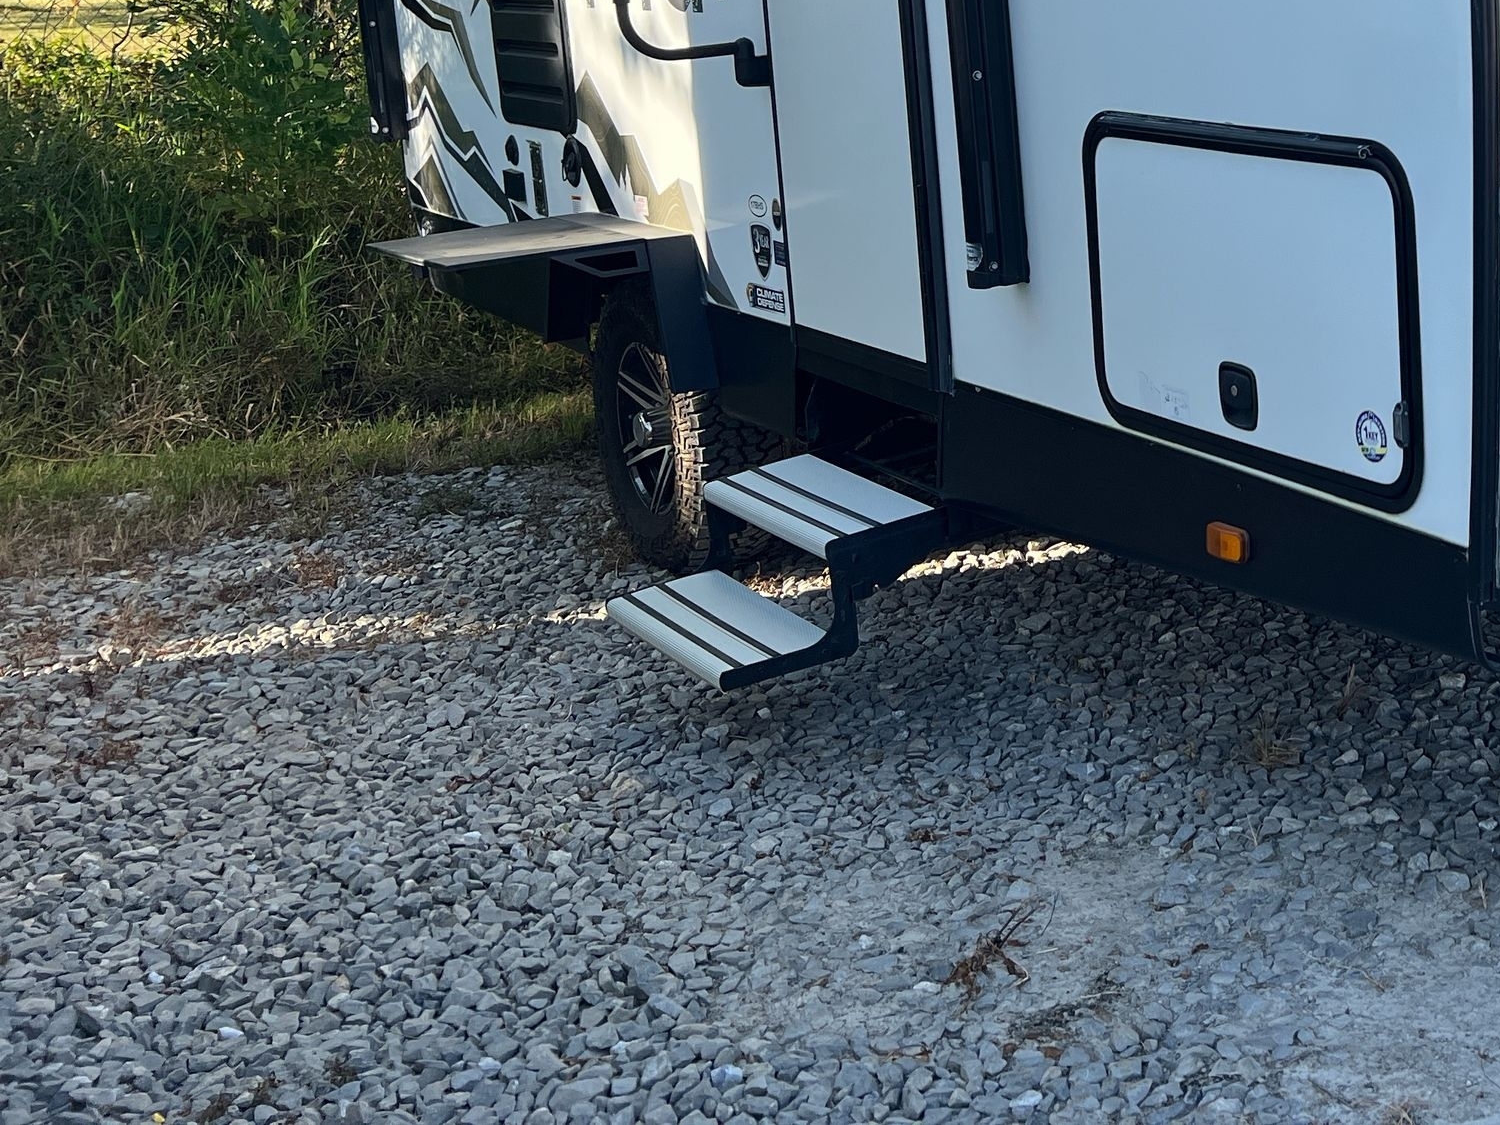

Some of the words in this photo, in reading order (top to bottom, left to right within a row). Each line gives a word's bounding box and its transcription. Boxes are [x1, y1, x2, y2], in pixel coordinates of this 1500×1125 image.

[752, 228, 760, 253] 3
[757, 287, 784, 303] CLIMATE
[757, 297, 785, 312] DEFENSE
